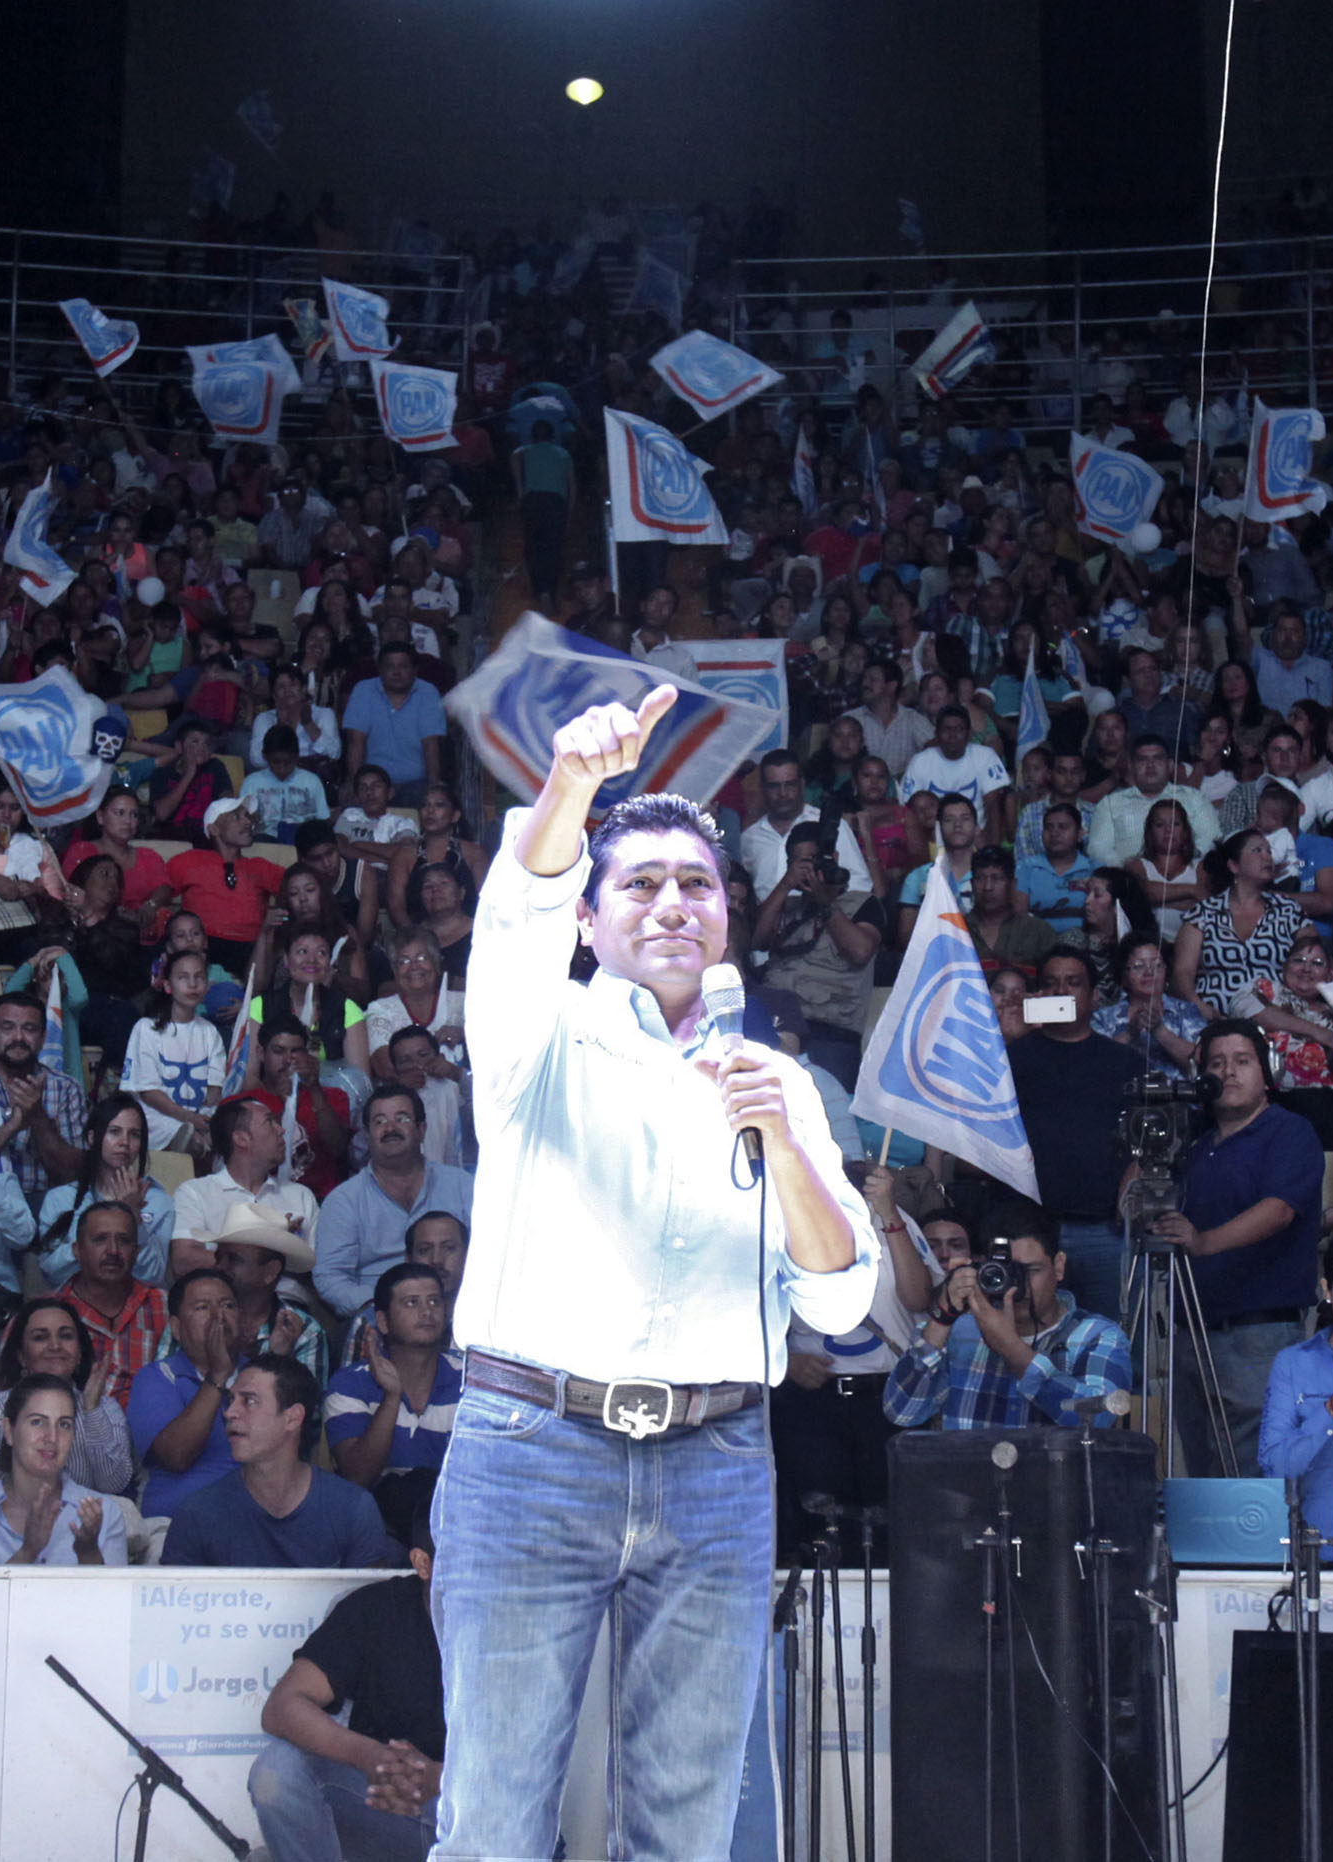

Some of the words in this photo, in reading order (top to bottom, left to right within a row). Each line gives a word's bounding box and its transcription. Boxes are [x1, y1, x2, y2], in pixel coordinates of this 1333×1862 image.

[400, 391, 437, 418] PAN
[651, 453, 690, 494] PAN
[1095, 470, 1137, 514] PAN
[1, 718, 64, 772] PAN
[141, 1586, 273, 1613] ¡Alégrate,
[180, 1623, 211, 1645] ya
[220, 1623, 248, 1639] se
[258, 1616, 314, 1639] van!
[183, 1667, 258, 1698] Jorge
